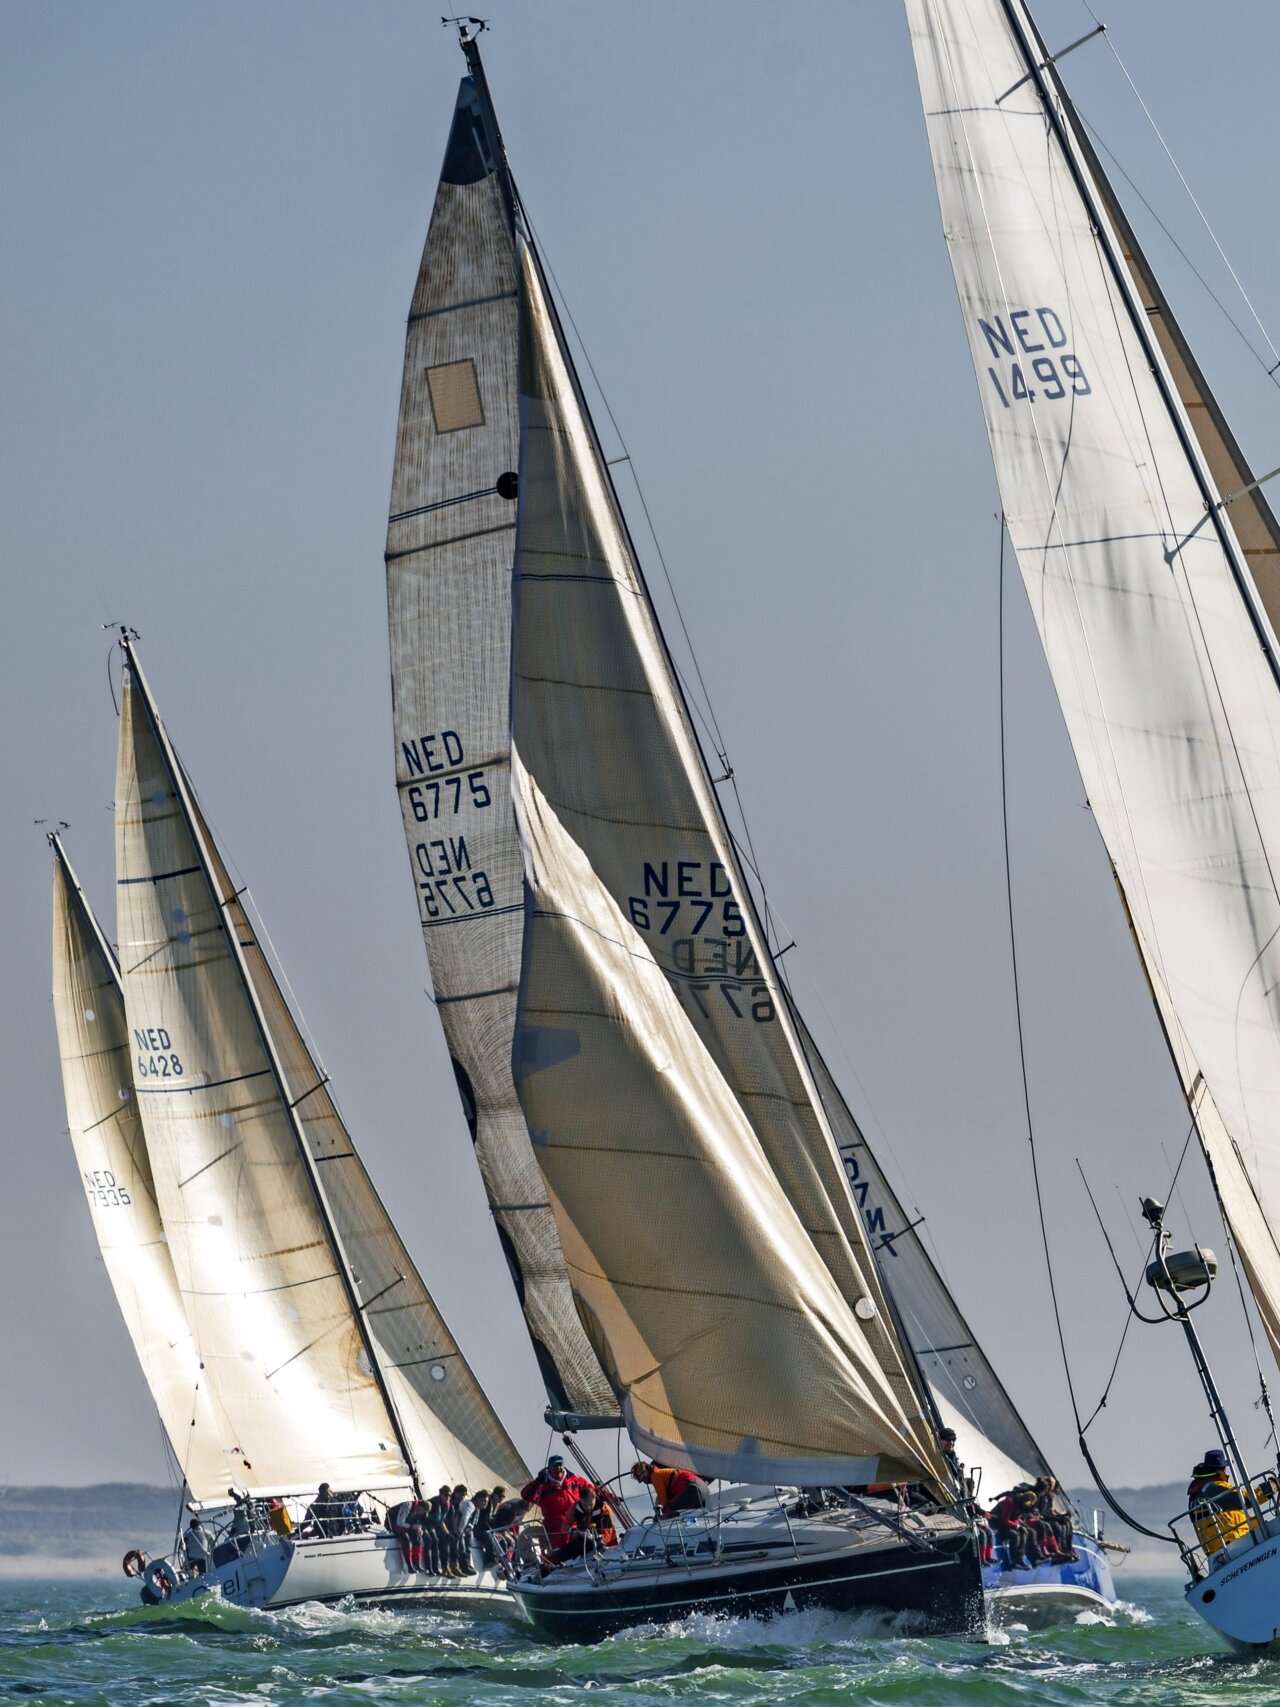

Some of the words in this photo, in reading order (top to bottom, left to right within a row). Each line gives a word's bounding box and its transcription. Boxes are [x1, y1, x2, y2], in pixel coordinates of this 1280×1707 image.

[977, 307, 1068, 359] NED
[987, 354, 1092, 409] 1499
[401, 730, 464, 777] NED
[408, 771, 492, 822] 6775
[643, 861, 733, 898] NED
[628, 896, 747, 937] 6775
[134, 1028, 172, 1051] NED
[138, 1053, 184, 1078] 6428
[84, 1170, 116, 1189] NED
[88, 1187, 132, 1208] 7935
[1220, 1547, 1278, 1588] SCHEVENINGEN
